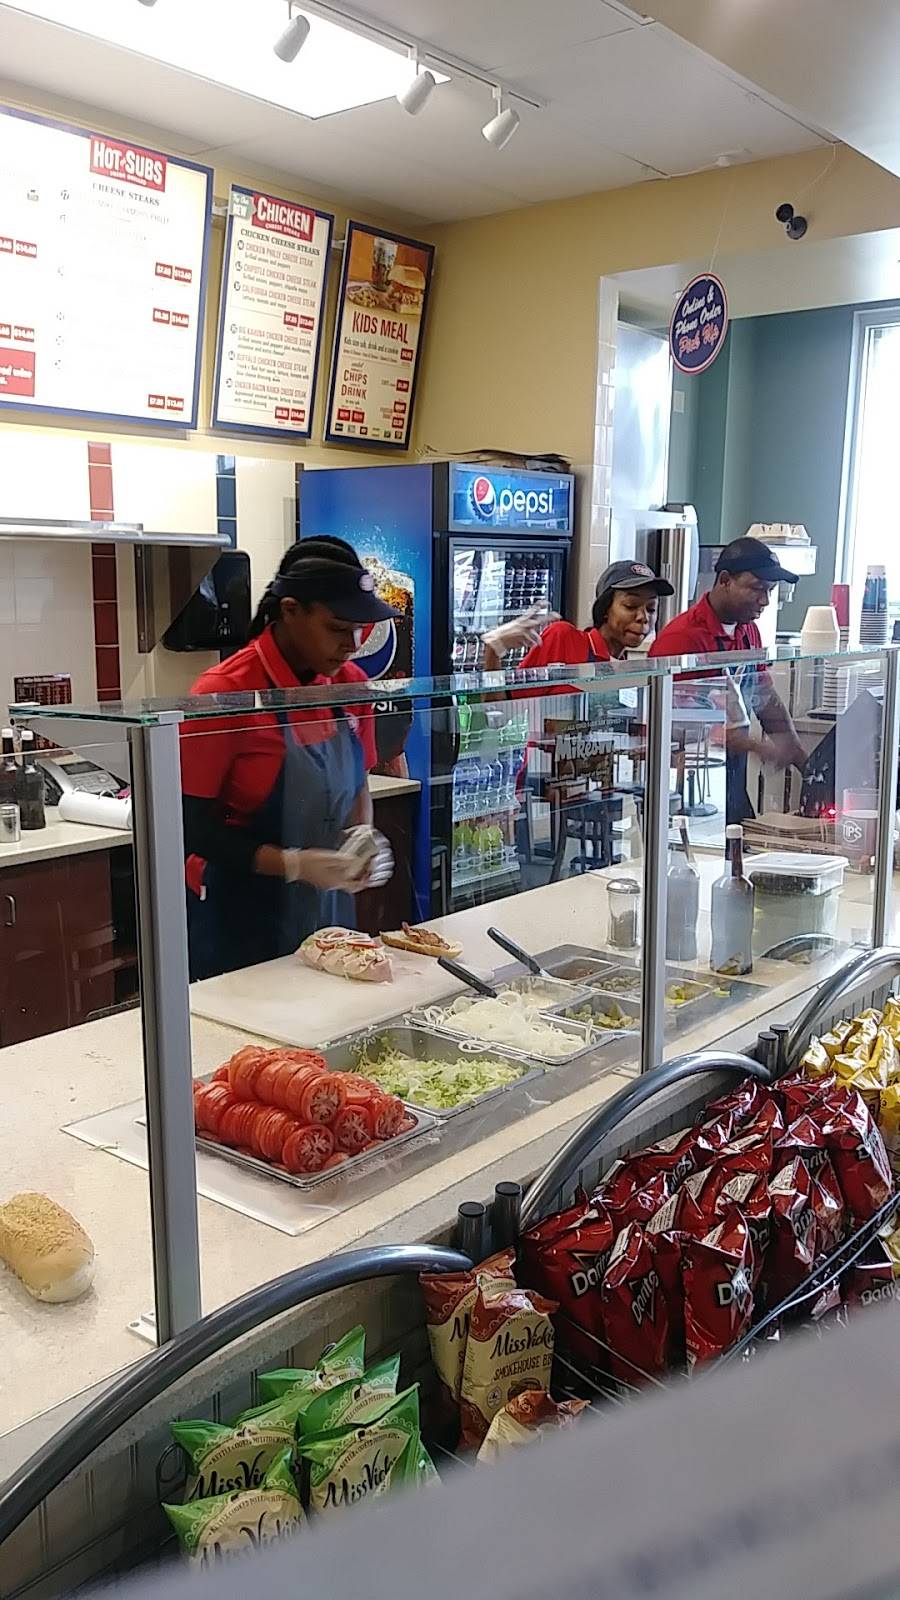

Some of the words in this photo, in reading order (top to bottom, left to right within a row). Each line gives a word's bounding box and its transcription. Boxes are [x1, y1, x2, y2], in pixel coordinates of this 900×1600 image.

[93, 139, 122, 171] HOT
[125, 150, 163, 186] SUBS
[128, 191, 161, 207] STEAKS
[257, 196, 311, 236] CHICKEN
[240, 228, 270, 242] CHICKEN
[271, 236, 296, 249] CHEESE
[296, 244, 321, 256] STEAKS
[682, 296, 706, 317] Online
[707, 285, 715, 304] &
[352, 310, 379, 335] KIDS
[380, 319, 409, 345] MEAL
[341, 383, 367, 400] DRINK
[343, 369, 368, 386] CHIPS
[500, 488, 553, 519] pepsi
[632, 1270, 660, 1325] Doritos
[490, 1331, 524, 1360] Miss
[494, 1353, 541, 1381] SMOKEHOUSE
[189, 1471, 242, 1500] Miss
[323, 1477, 368, 1508] Miss
